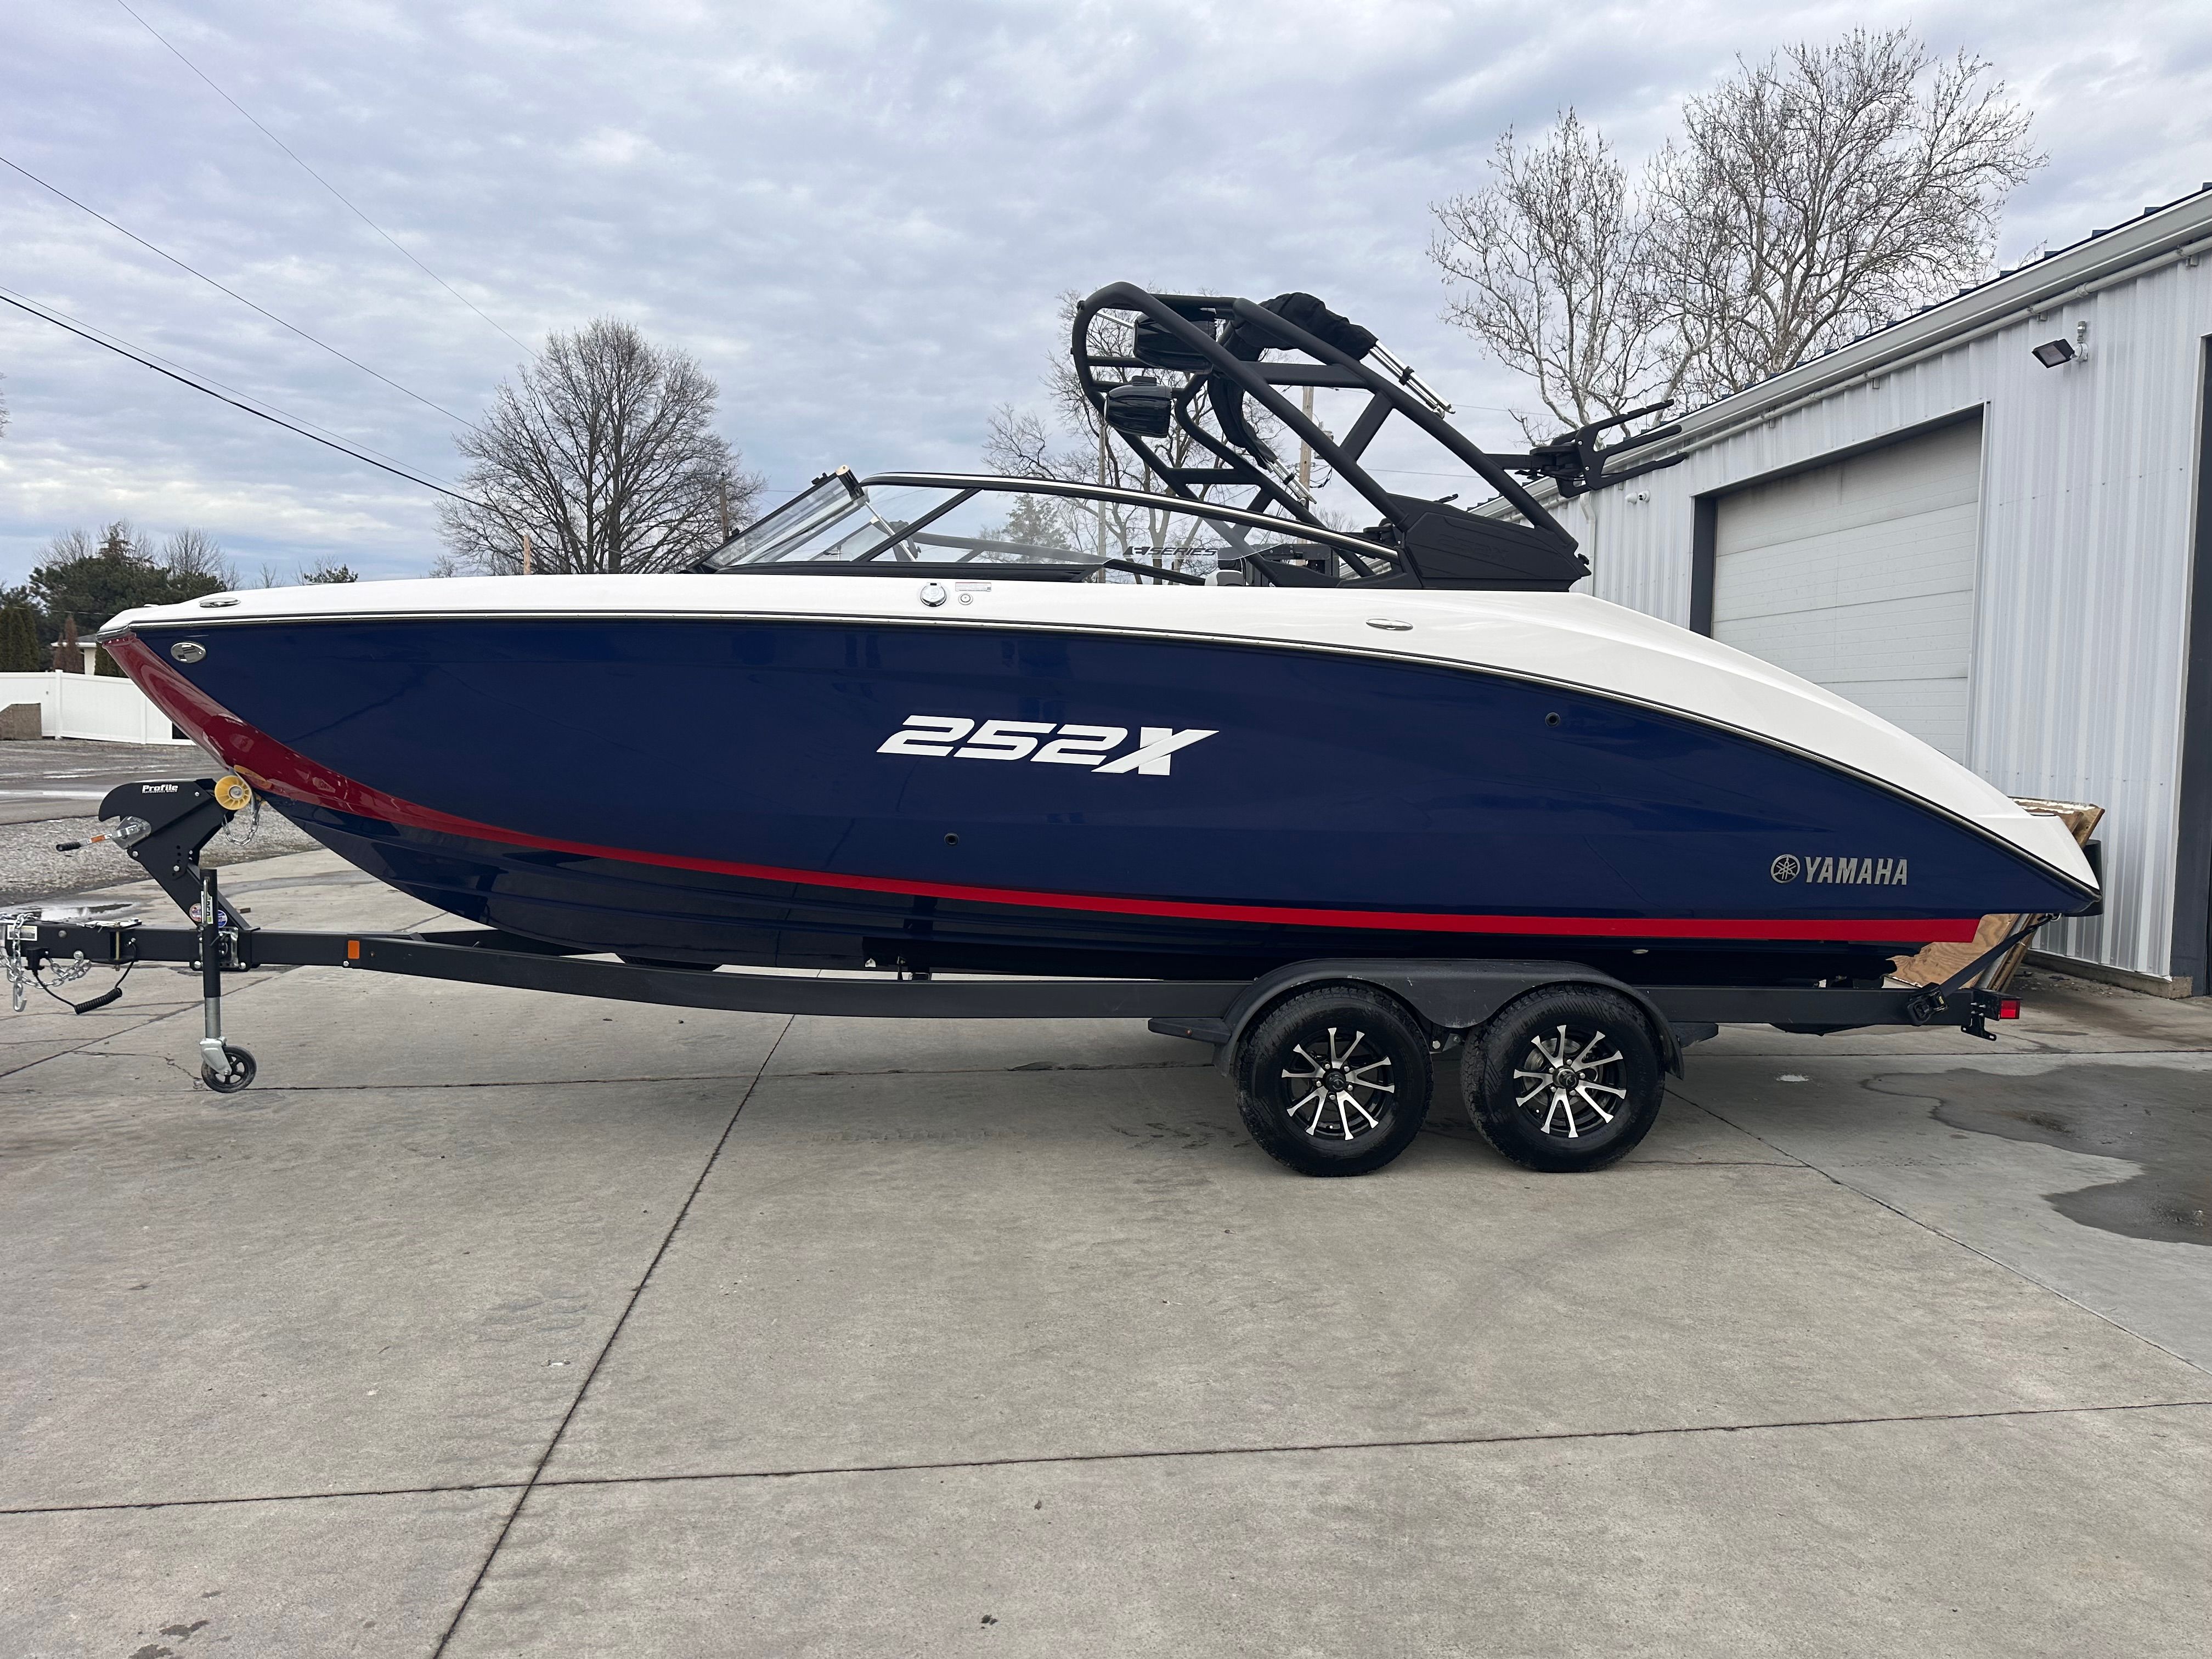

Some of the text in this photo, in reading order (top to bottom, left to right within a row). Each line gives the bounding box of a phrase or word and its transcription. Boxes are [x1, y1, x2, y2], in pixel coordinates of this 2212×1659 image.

[1148, 547, 1218, 556] SERIES
[876, 715, 1220, 776] 252X
[1804, 856, 1908, 885] YAMAHA
